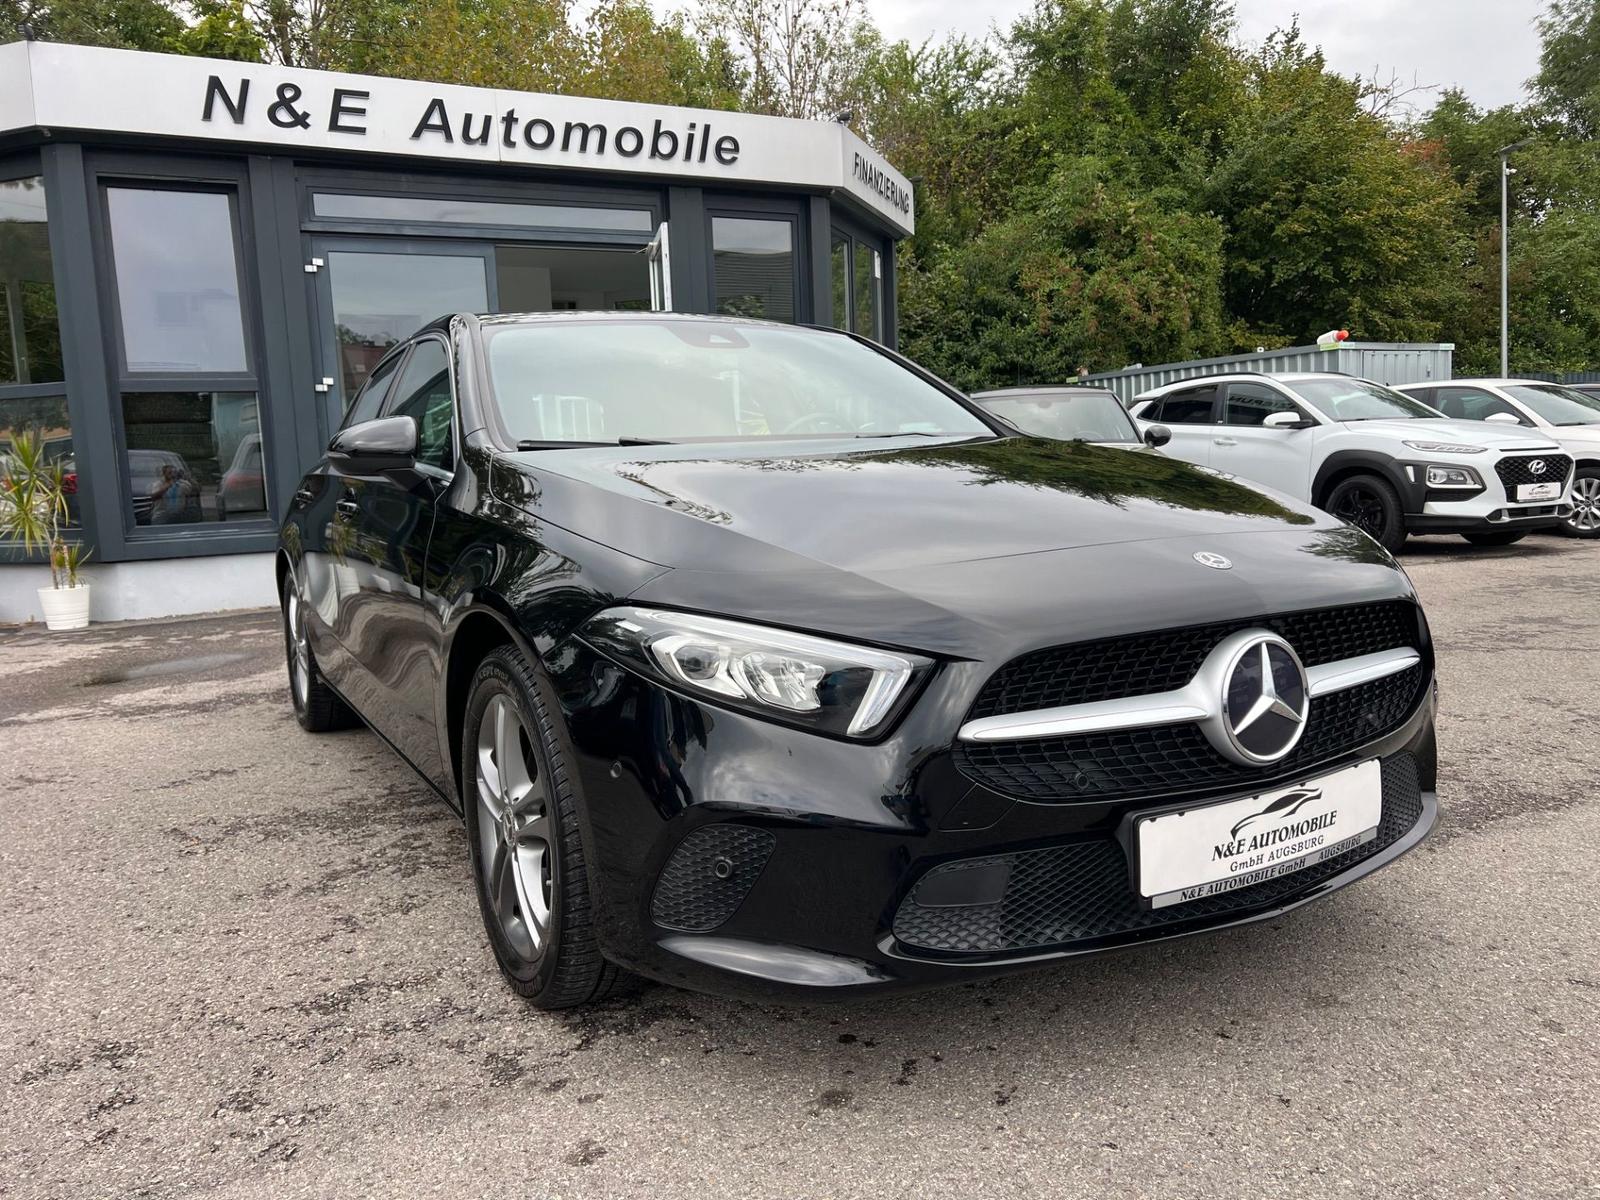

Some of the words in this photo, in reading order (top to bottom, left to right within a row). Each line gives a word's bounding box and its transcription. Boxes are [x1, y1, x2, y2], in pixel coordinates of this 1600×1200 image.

[202, 75, 250, 124] N
[267, 82, 311, 130] &
[327, 88, 370, 135] E
[409, 98, 741, 165] Automobile
[853, 151, 910, 214] FINANZIERUNG
[1211, 838, 1246, 862] N&E
[1248, 810, 1338, 851] AUTOMOBILE
[1230, 853, 1264, 873] GmbH
[1267, 835, 1325, 862] AUGSBURG
[1317, 835, 1362, 861] AUGSBURG
[1180, 886, 1205, 902] N&E
[1205, 868, 1277, 896] AUTOMOBILE
[1278, 858, 1306, 875] GmbH
